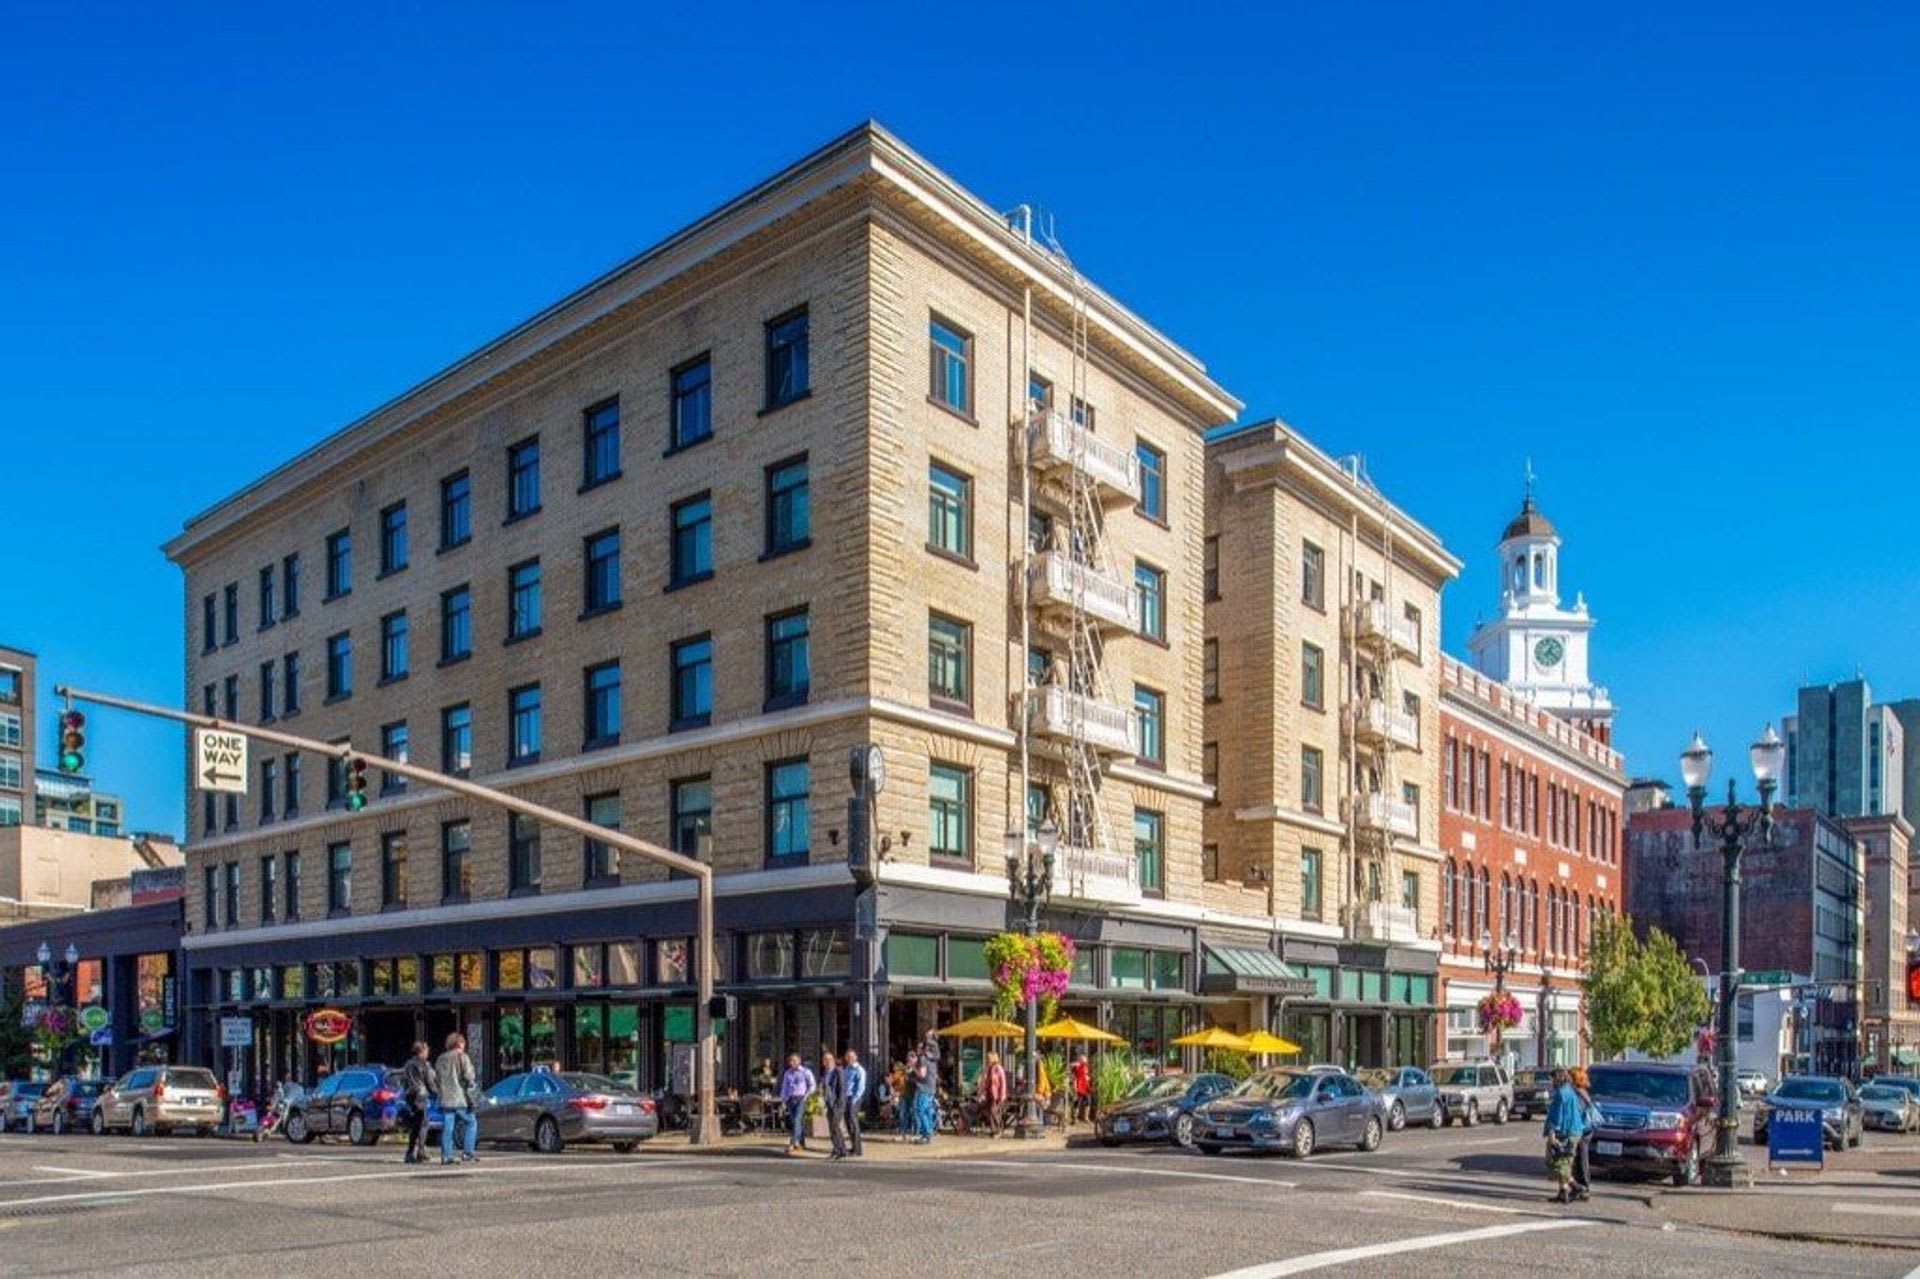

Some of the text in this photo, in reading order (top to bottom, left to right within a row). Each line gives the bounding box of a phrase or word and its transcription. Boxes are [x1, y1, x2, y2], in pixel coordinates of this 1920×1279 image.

[204, 734, 242, 751] ONE
[204, 749, 242, 766] WAY
[1775, 1110, 1815, 1123] PARK
